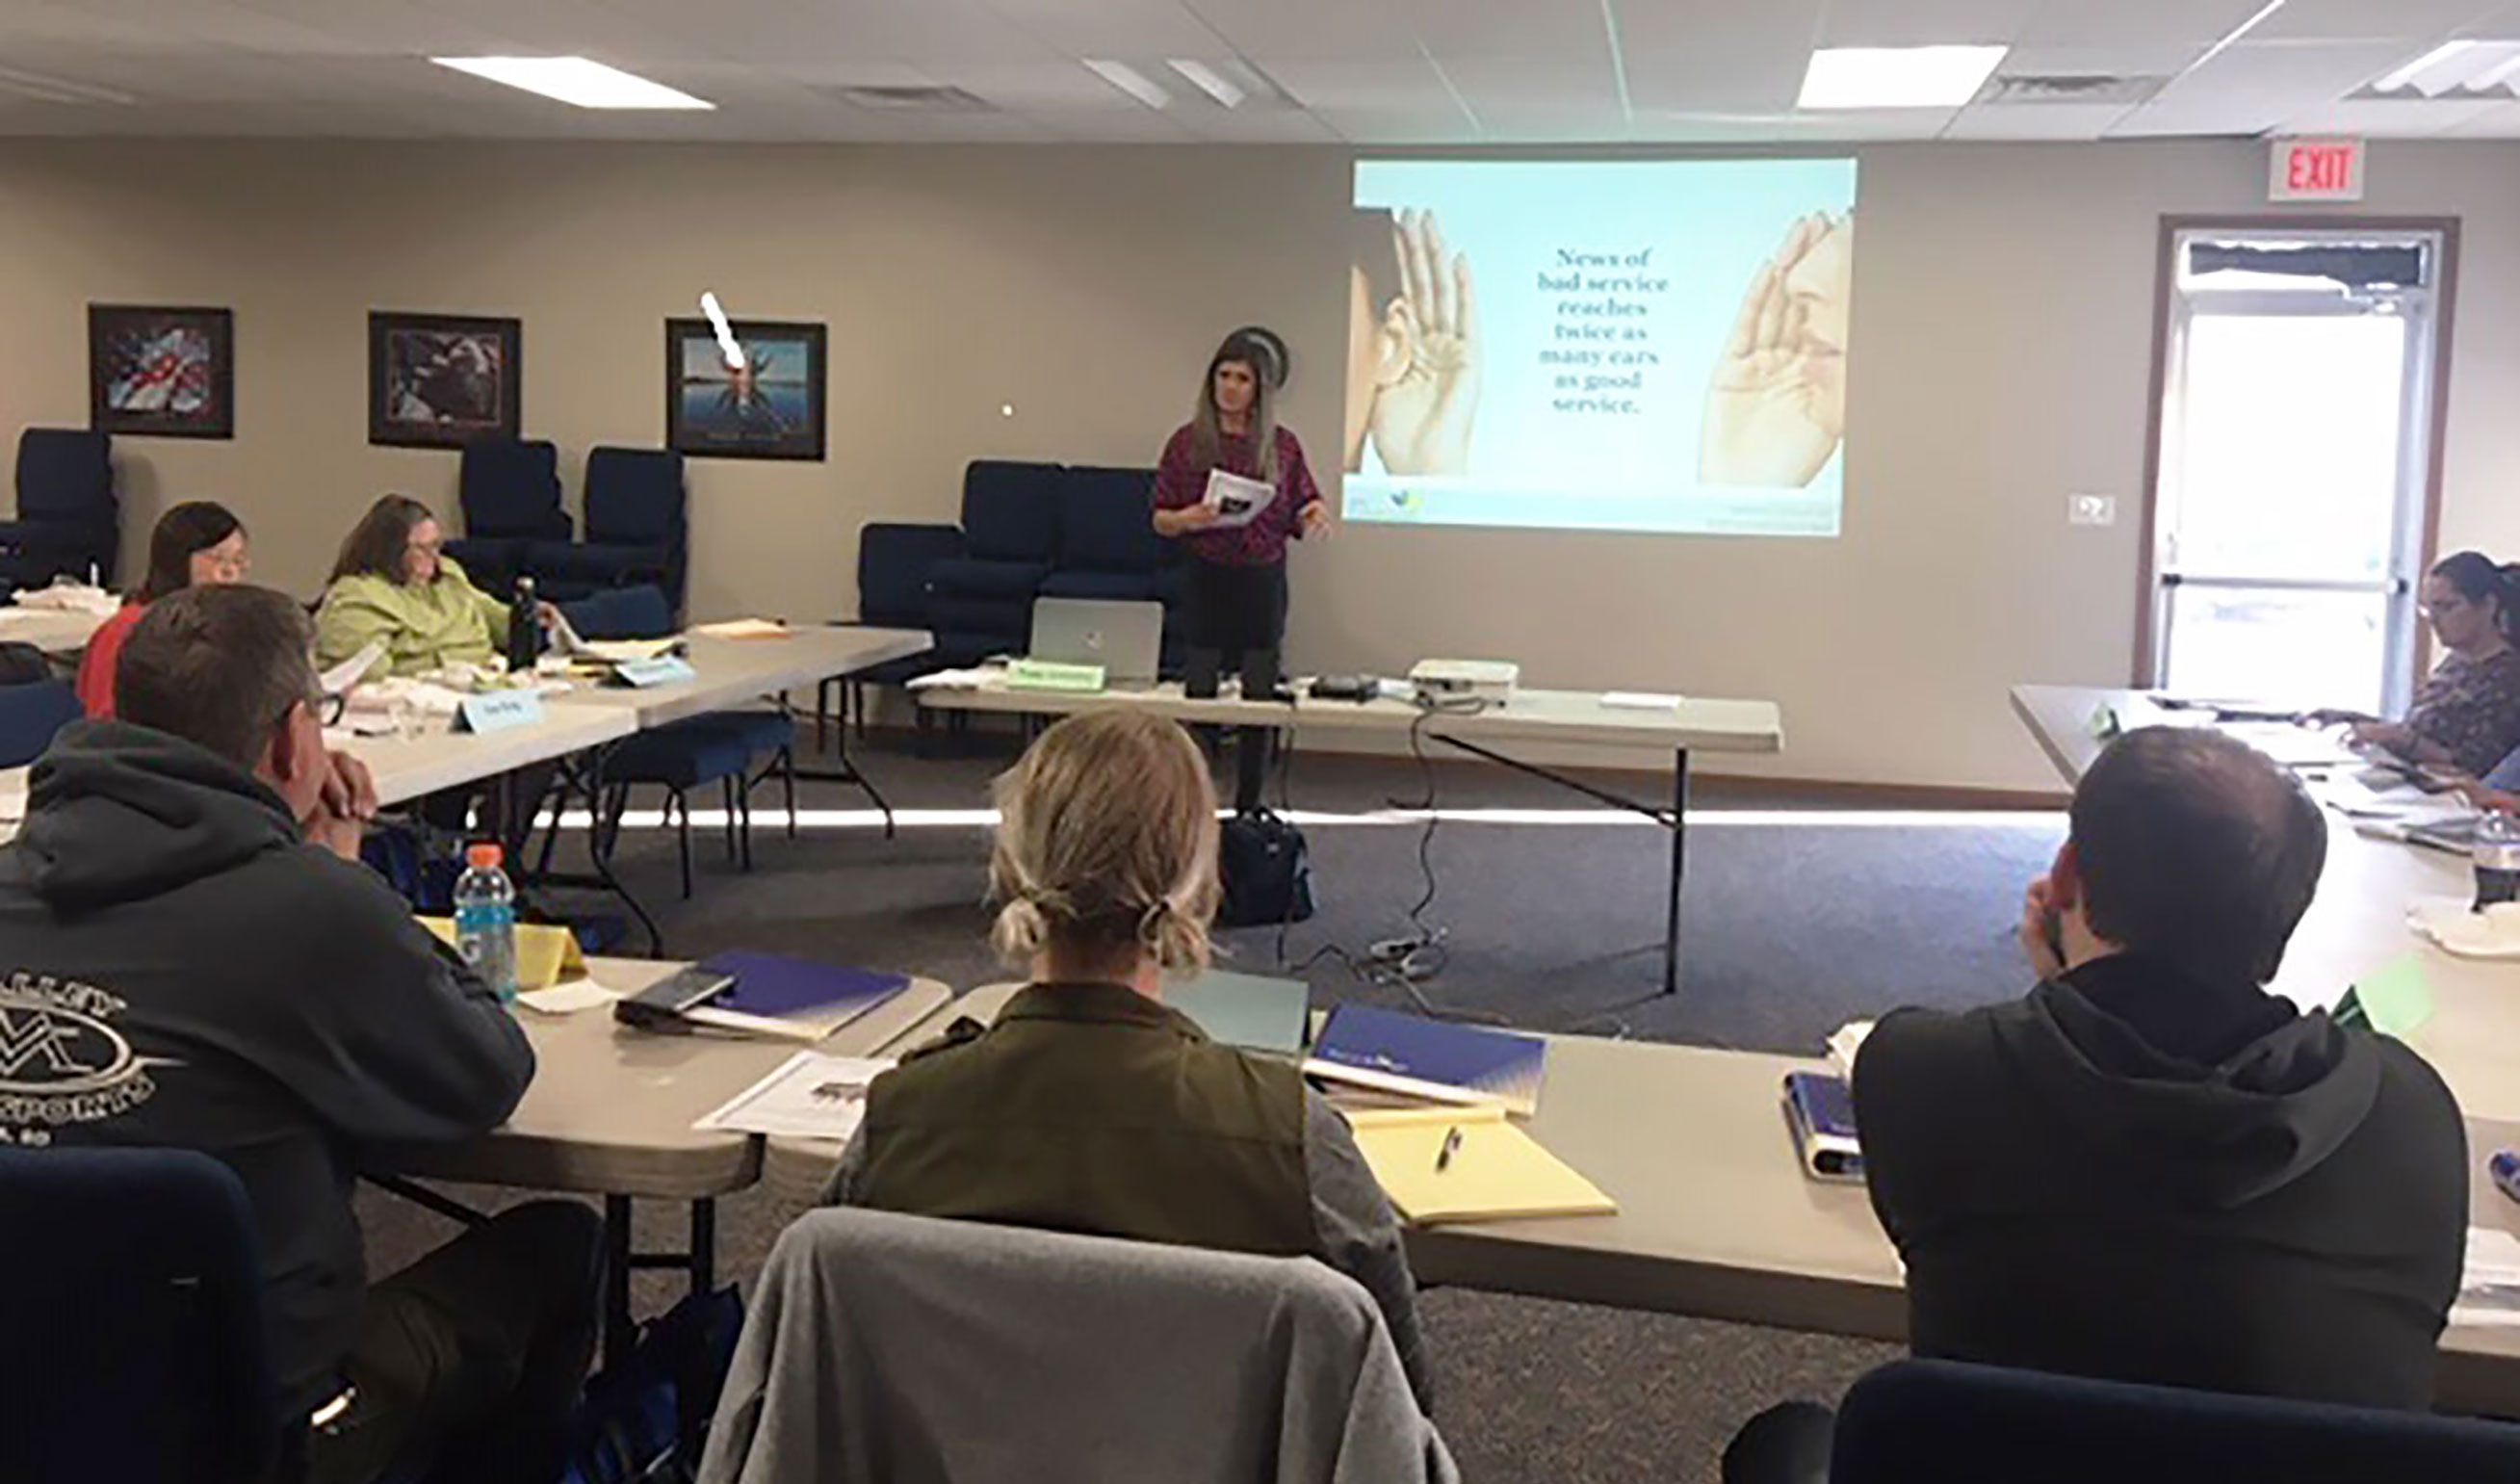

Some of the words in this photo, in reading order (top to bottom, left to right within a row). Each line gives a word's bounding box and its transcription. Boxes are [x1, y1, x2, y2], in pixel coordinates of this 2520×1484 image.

[2288, 145, 2352, 190] EXIT
[1557, 248, 1619, 266] News
[1624, 247, 1653, 267] of
[1538, 272, 1580, 290] bad
[1587, 273, 1669, 291] service
[1557, 297, 1649, 315] reaches
[1554, 323, 1617, 340] twice
[1622, 326, 1649, 340] as
[1538, 350, 1603, 368] many
[1608, 350, 1660, 365] ears
[1554, 374, 1580, 389] as
[1583, 370, 1642, 392] good
[1552, 394, 1643, 414] service.
